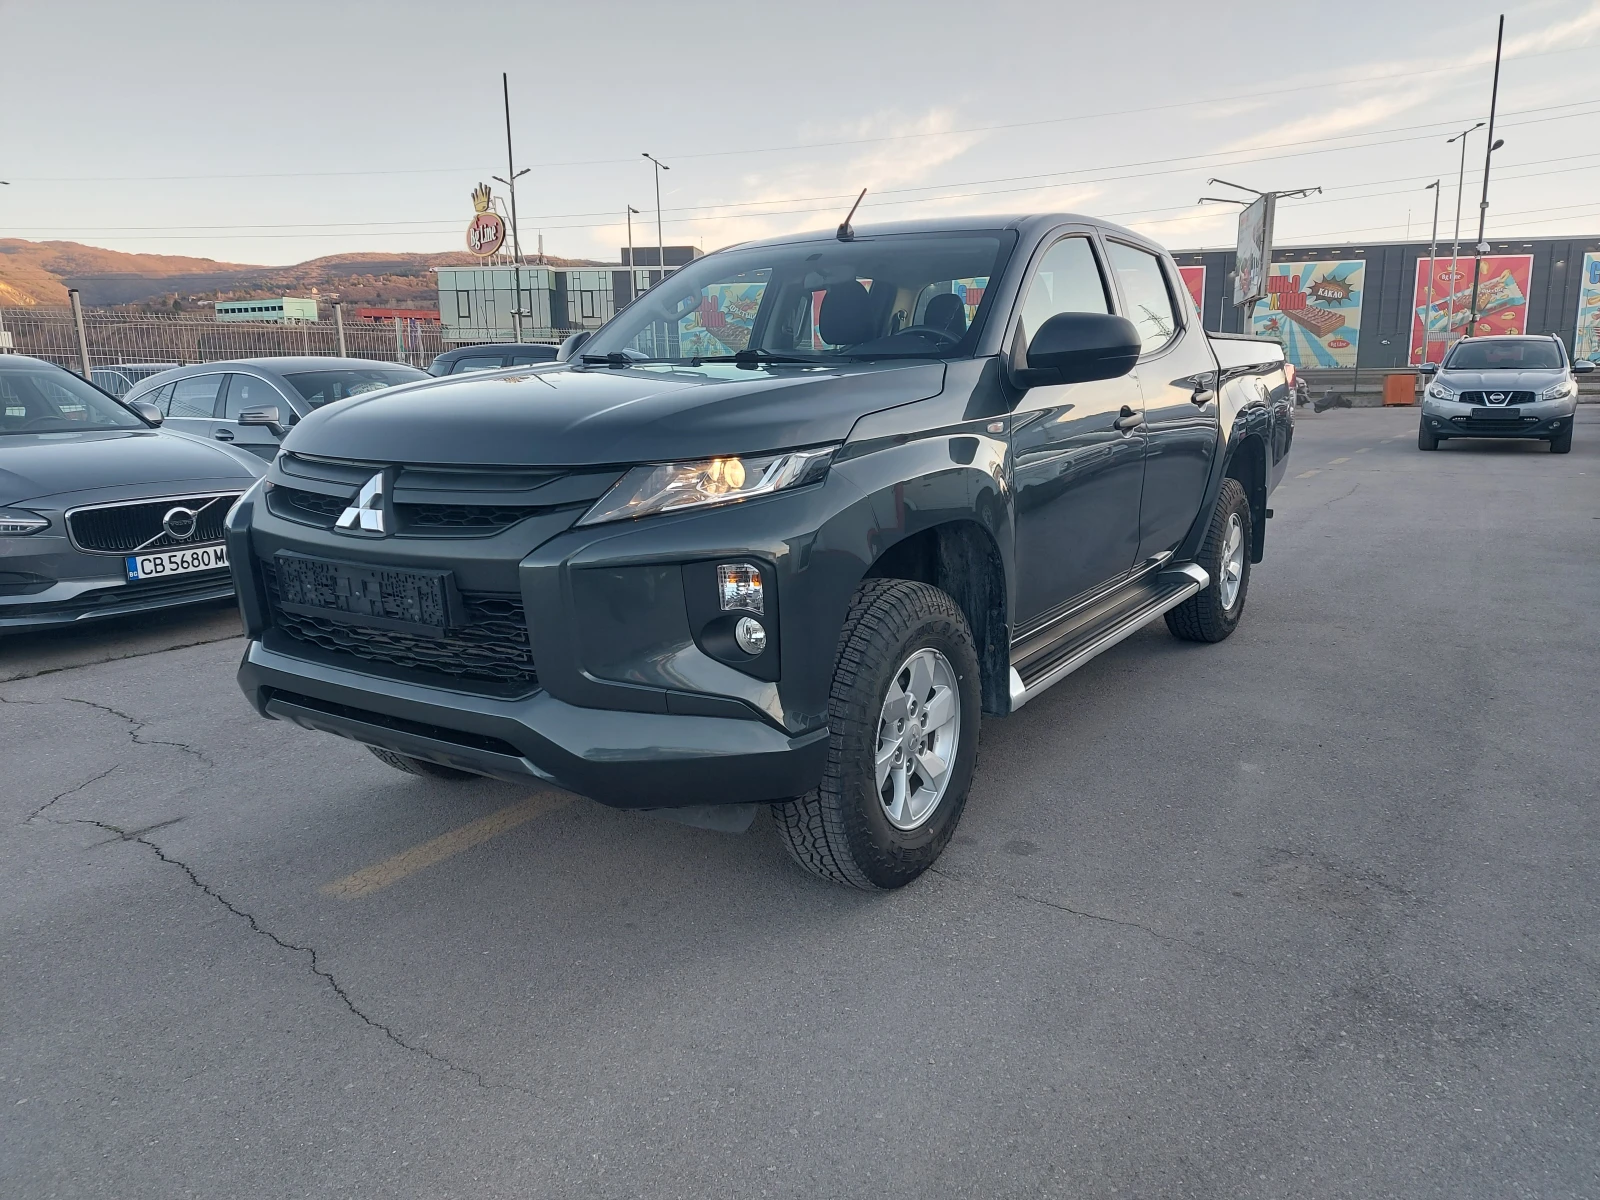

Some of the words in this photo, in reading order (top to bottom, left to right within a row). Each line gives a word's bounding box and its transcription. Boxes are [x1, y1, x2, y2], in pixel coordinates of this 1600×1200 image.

[470, 227, 481, 249] Bg
[480, 225, 498, 243] Line
[140, 556, 165, 576] CB
[168, 550, 211, 571] 5680
[213, 547, 229, 566] M
